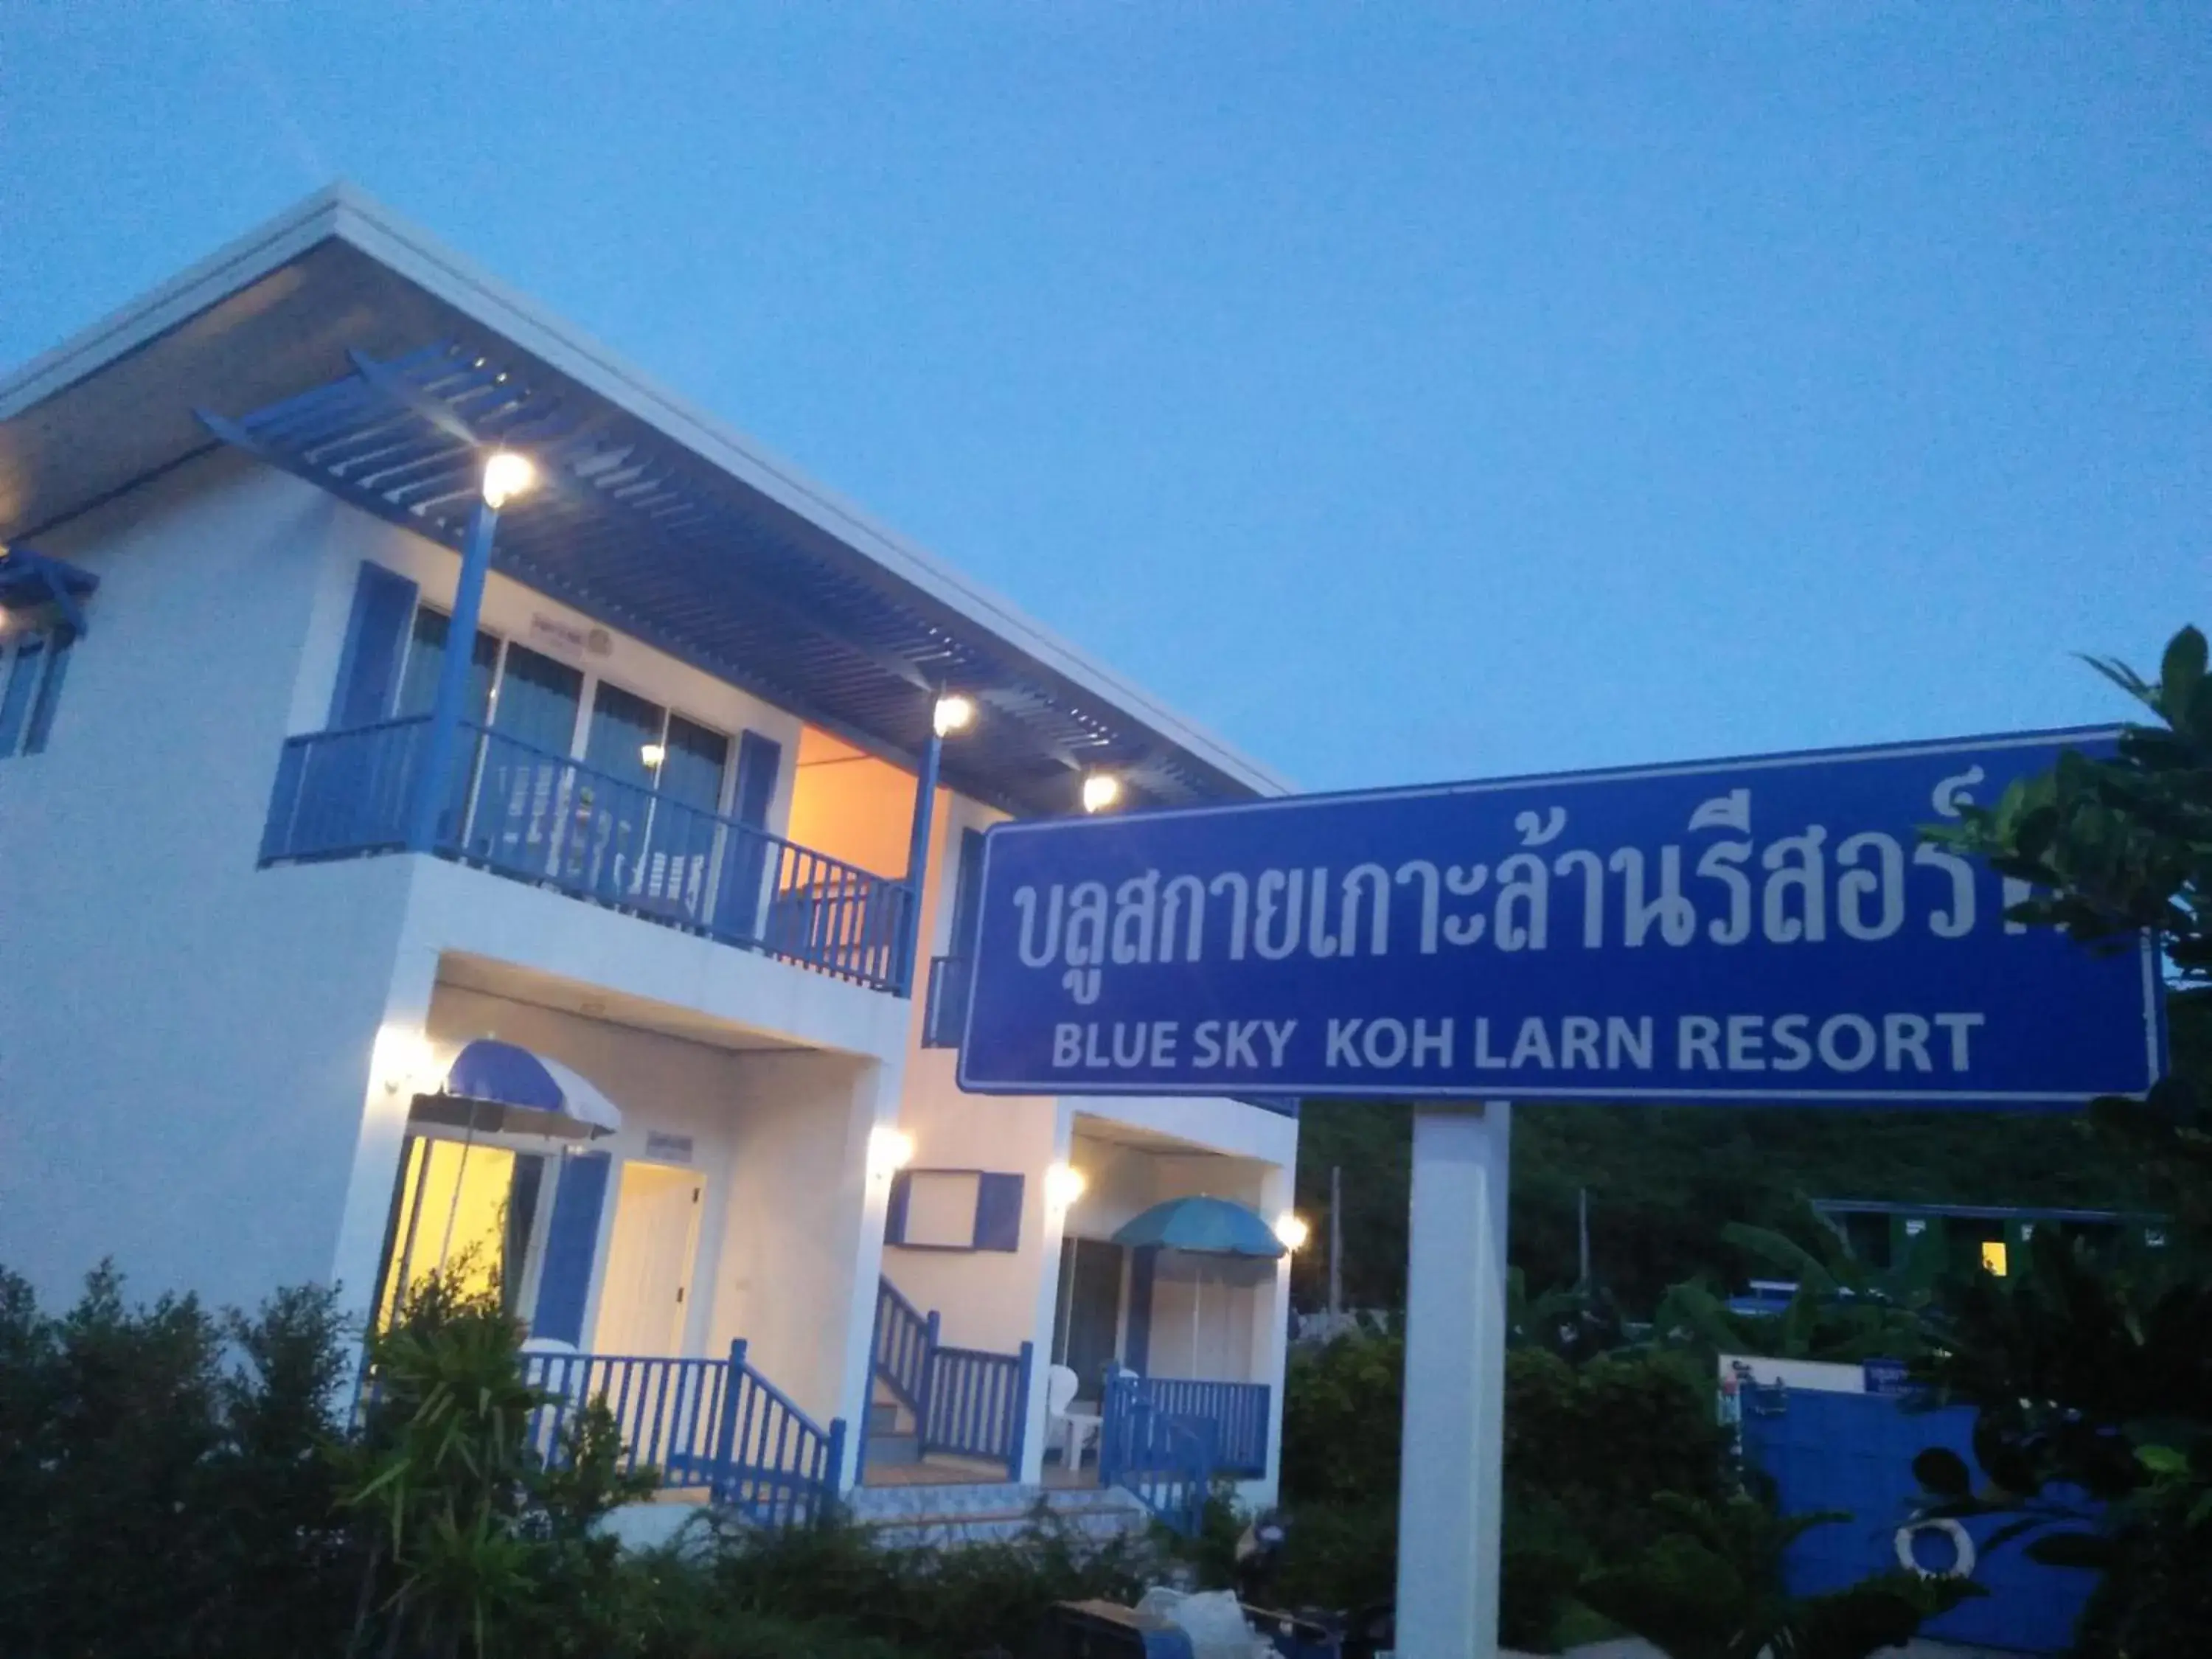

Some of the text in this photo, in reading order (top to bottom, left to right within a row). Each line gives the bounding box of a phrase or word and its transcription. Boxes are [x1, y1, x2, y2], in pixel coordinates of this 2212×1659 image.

[1014, 765, 2070, 1004] บลูสกายเกาะล้านรีสอร์
[1052, 1012, 1986, 1071] BLUE SKY KOH LARN RESORT
